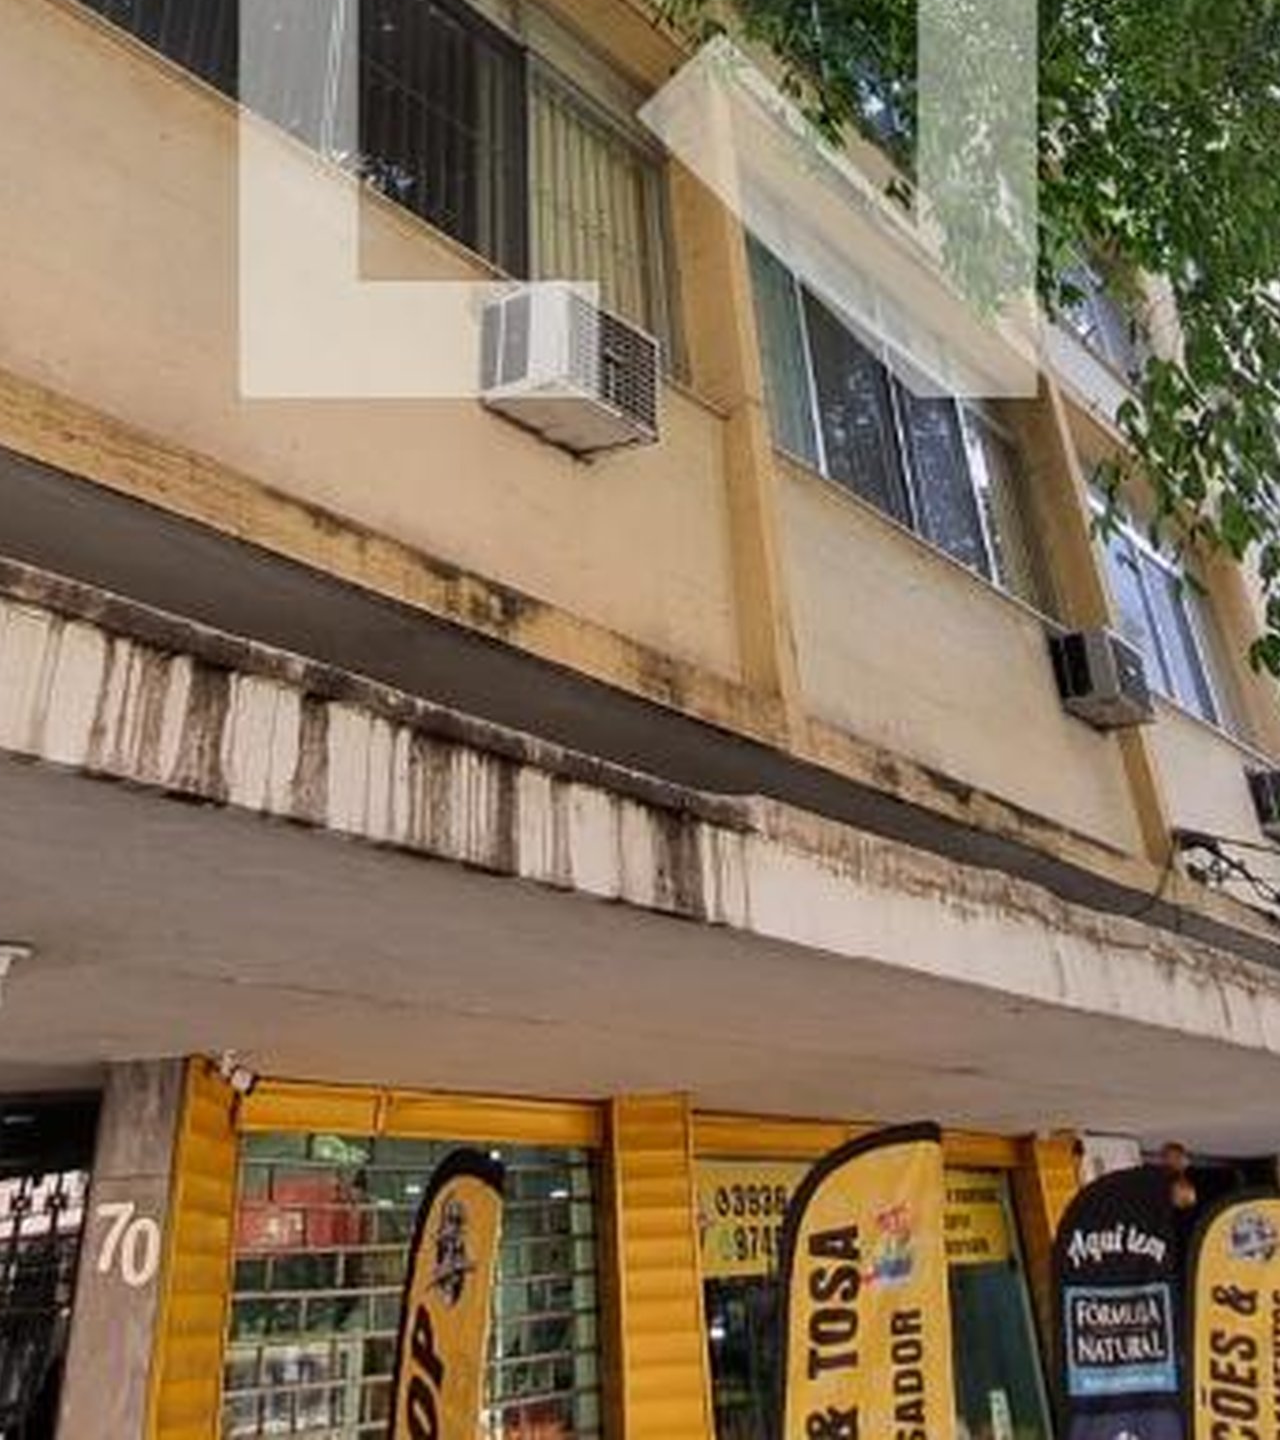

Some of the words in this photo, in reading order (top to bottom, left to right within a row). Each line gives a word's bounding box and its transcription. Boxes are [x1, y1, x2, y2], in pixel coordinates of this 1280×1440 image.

[96, 1202, 160, 1286] 70
[808, 1224, 861, 1381] TOSA
[1211, 1283, 1259, 1317] &
[1077, 1331, 1165, 1364] NATURAL
